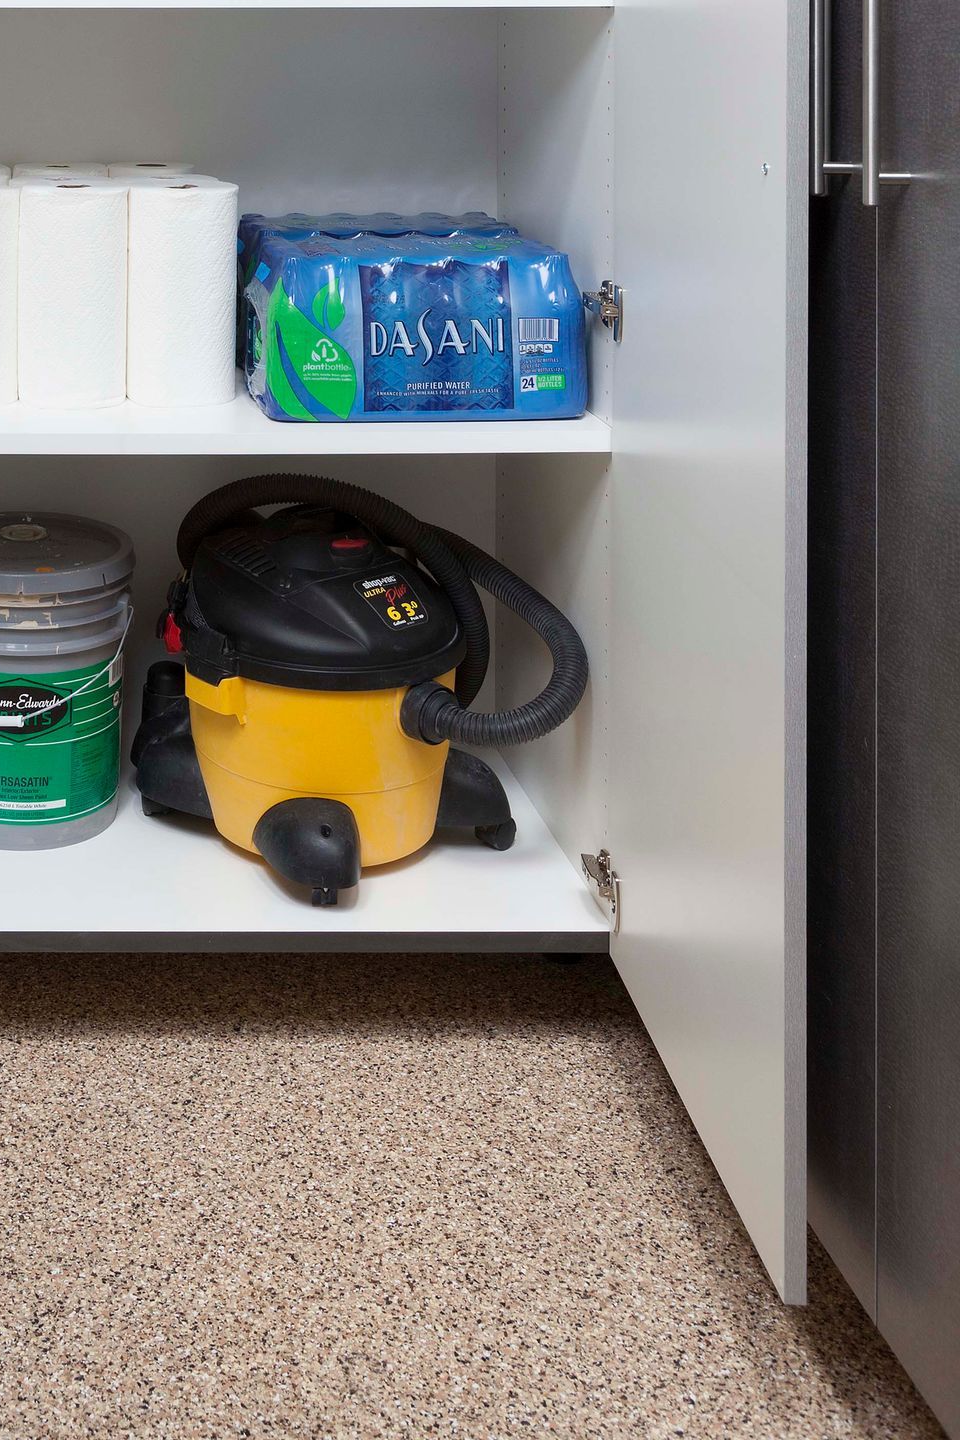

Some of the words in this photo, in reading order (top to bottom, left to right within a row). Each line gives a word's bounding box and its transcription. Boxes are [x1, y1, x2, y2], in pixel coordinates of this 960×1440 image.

[369, 307, 505, 367] DASANI
[303, 363, 349, 372] plantbottle
[406, 382, 443, 391] PURIFIED
[444, 381, 471, 389] WATER
[521, 376, 535, 390] 24
[363, 586, 387, 598] ULTRA
[385, 583, 407, 607] Plus
[387, 606, 402, 621] 6
